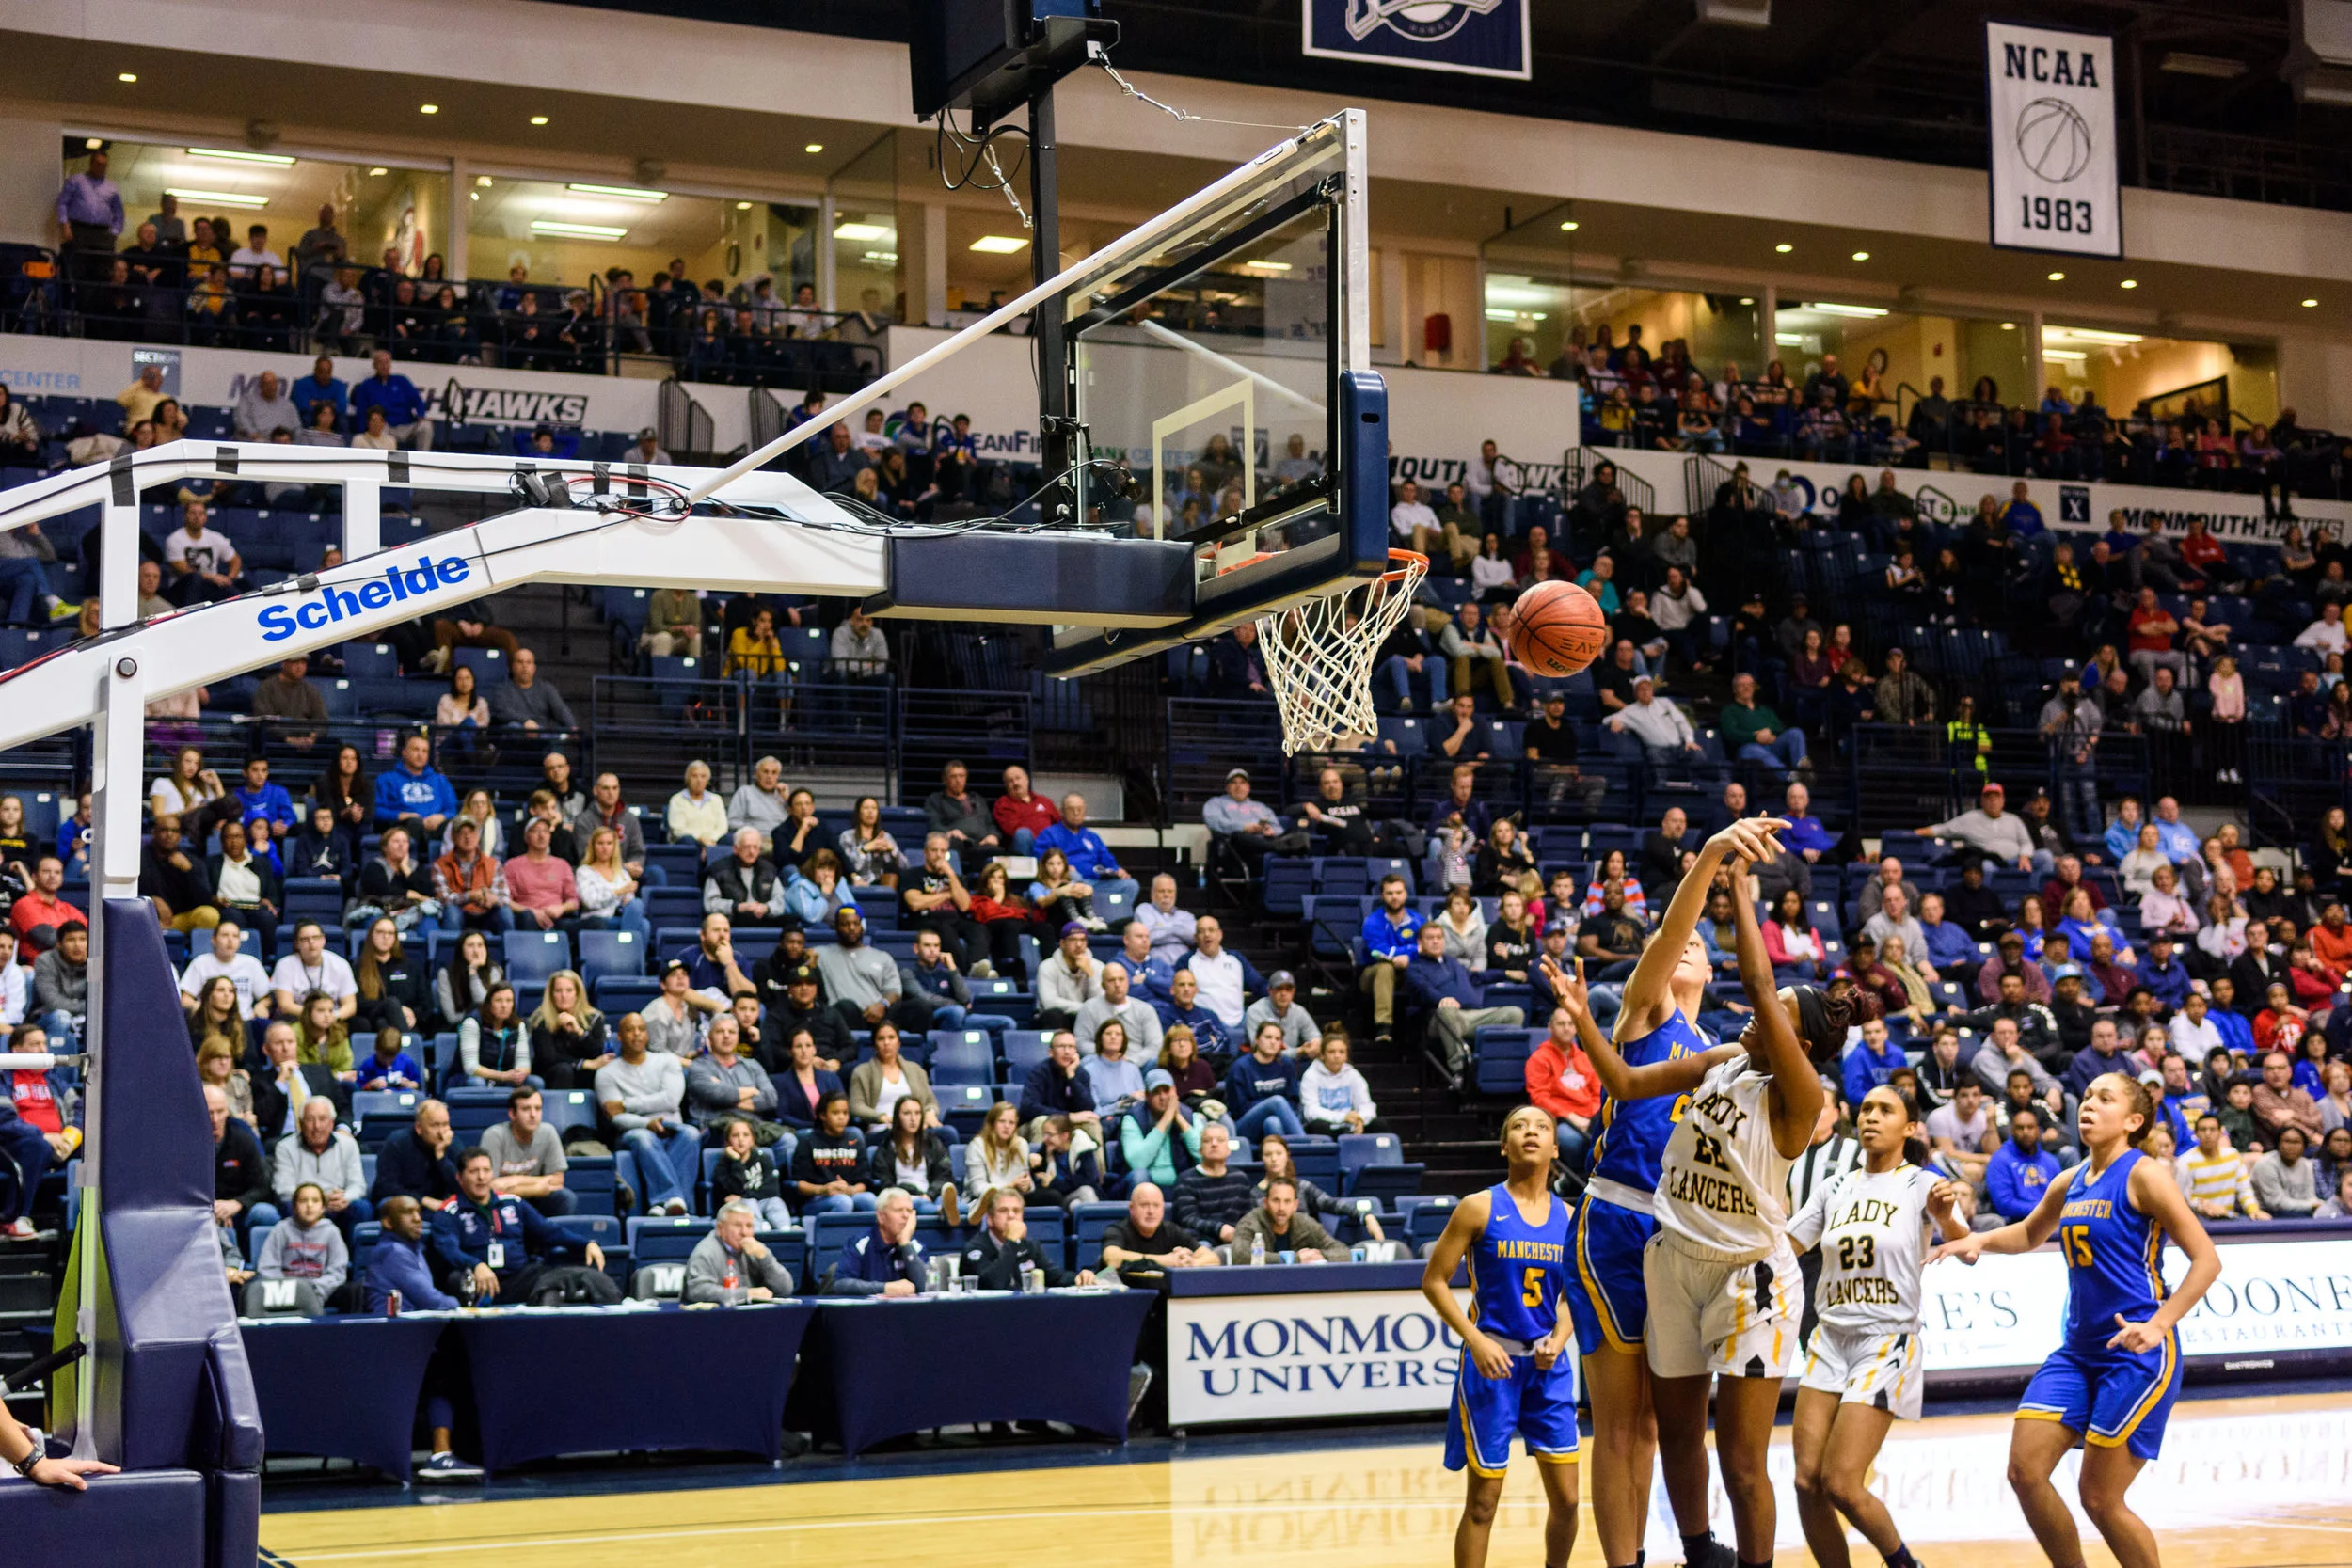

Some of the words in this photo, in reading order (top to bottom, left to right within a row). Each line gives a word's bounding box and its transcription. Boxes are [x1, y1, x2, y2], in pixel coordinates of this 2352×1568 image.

[2003, 42, 2099, 87] NCAA
[2022, 195, 2092, 234] 1983
[0, 369, 81, 388] CENTER
[464, 388, 585, 422] HAWKS
[2068, 499, 2083, 519] X
[258, 556, 469, 641] Schelde
[1669, 1166, 1757, 1217] LANCERS
[1828, 1199, 1899, 1233] LADY
[1497, 1240, 1564, 1264] MANCHEST
[1838, 1234, 1875, 1270] 23
[2061, 1225, 2093, 1268] 15
[261, 1280, 297, 1307] M
[650, 1266, 686, 1292] M
[1521, 1267, 1545, 1307] 5
[1827, 1277, 1899, 1307] LANCERS
[1186, 1313, 1462, 1361] MONMOU
[1200, 1358, 1459, 1397] UNIVERS
